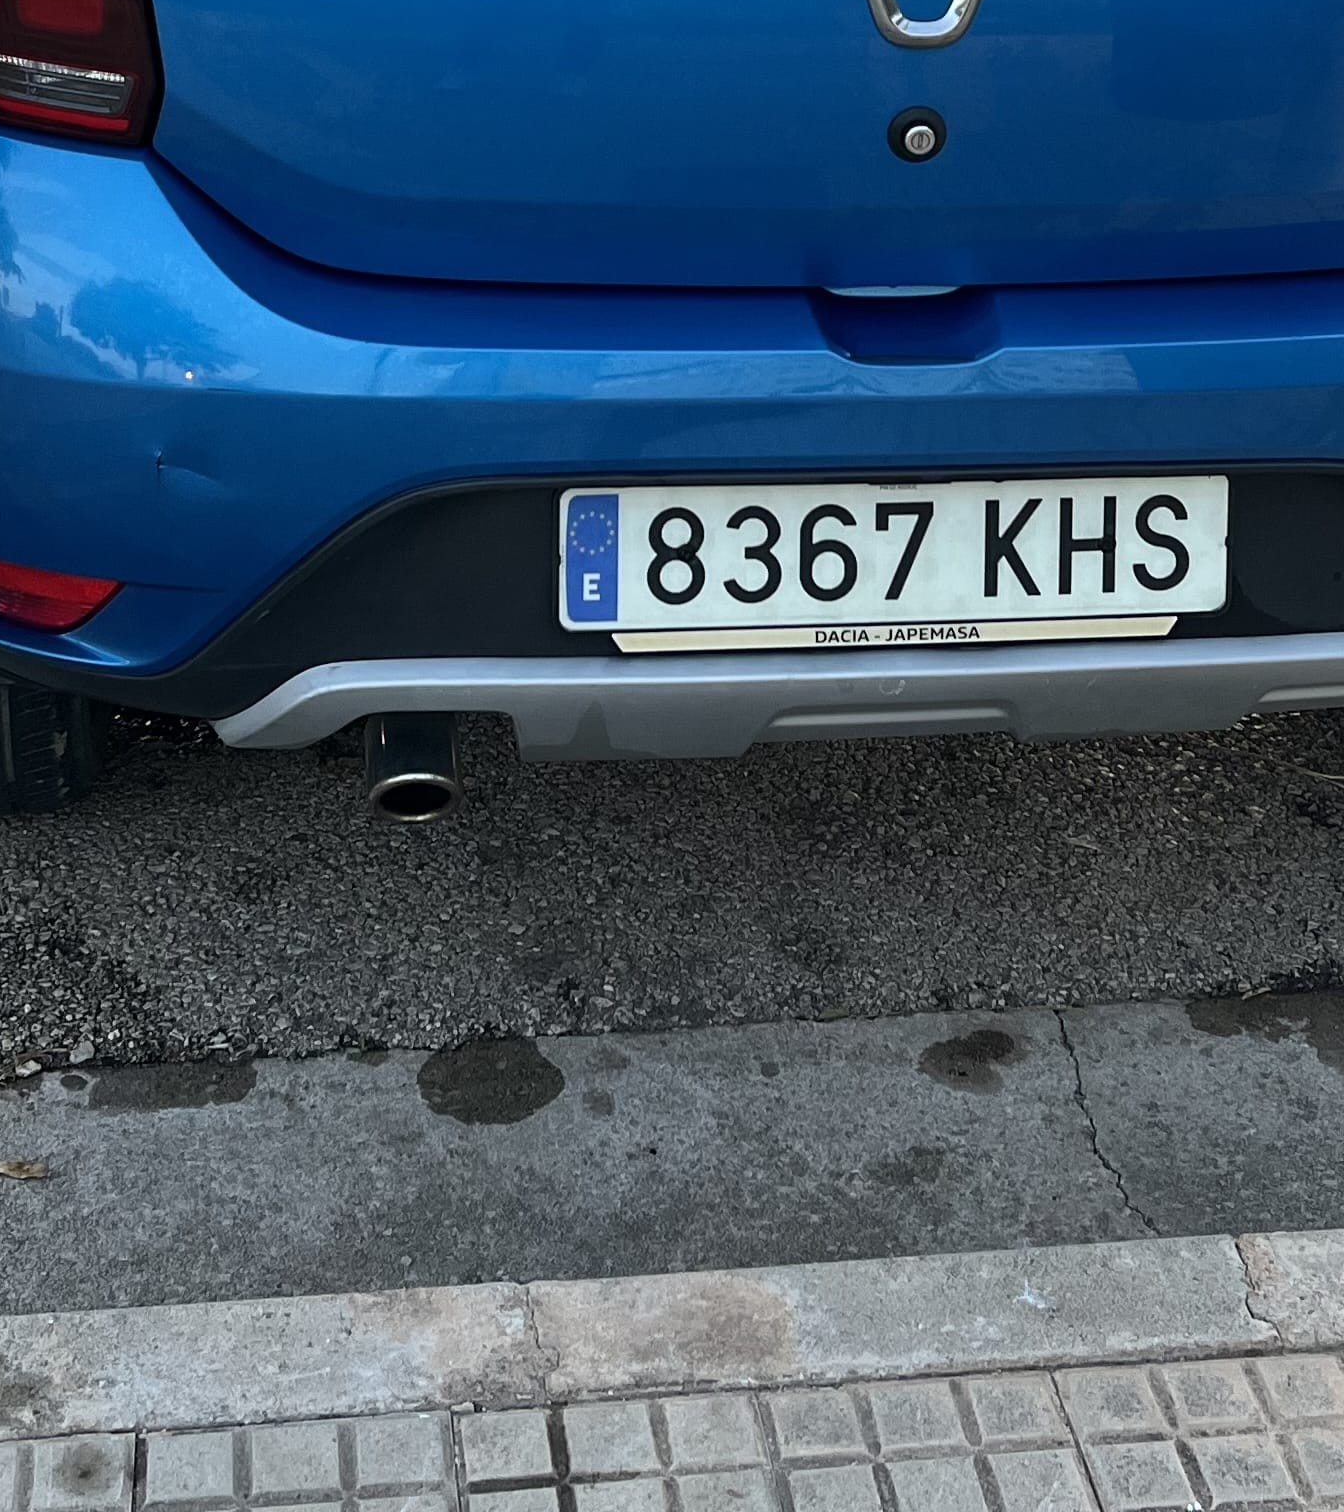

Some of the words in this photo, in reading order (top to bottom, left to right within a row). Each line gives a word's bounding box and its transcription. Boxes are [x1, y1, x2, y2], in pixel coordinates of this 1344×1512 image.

[645, 501, 935, 606] 8367
[983, 494, 1190, 599] KHS
[582, 572, 602, 602] E
[814, 628, 870, 644] DACIA
[884, 625, 981, 642] JAPEMASA
